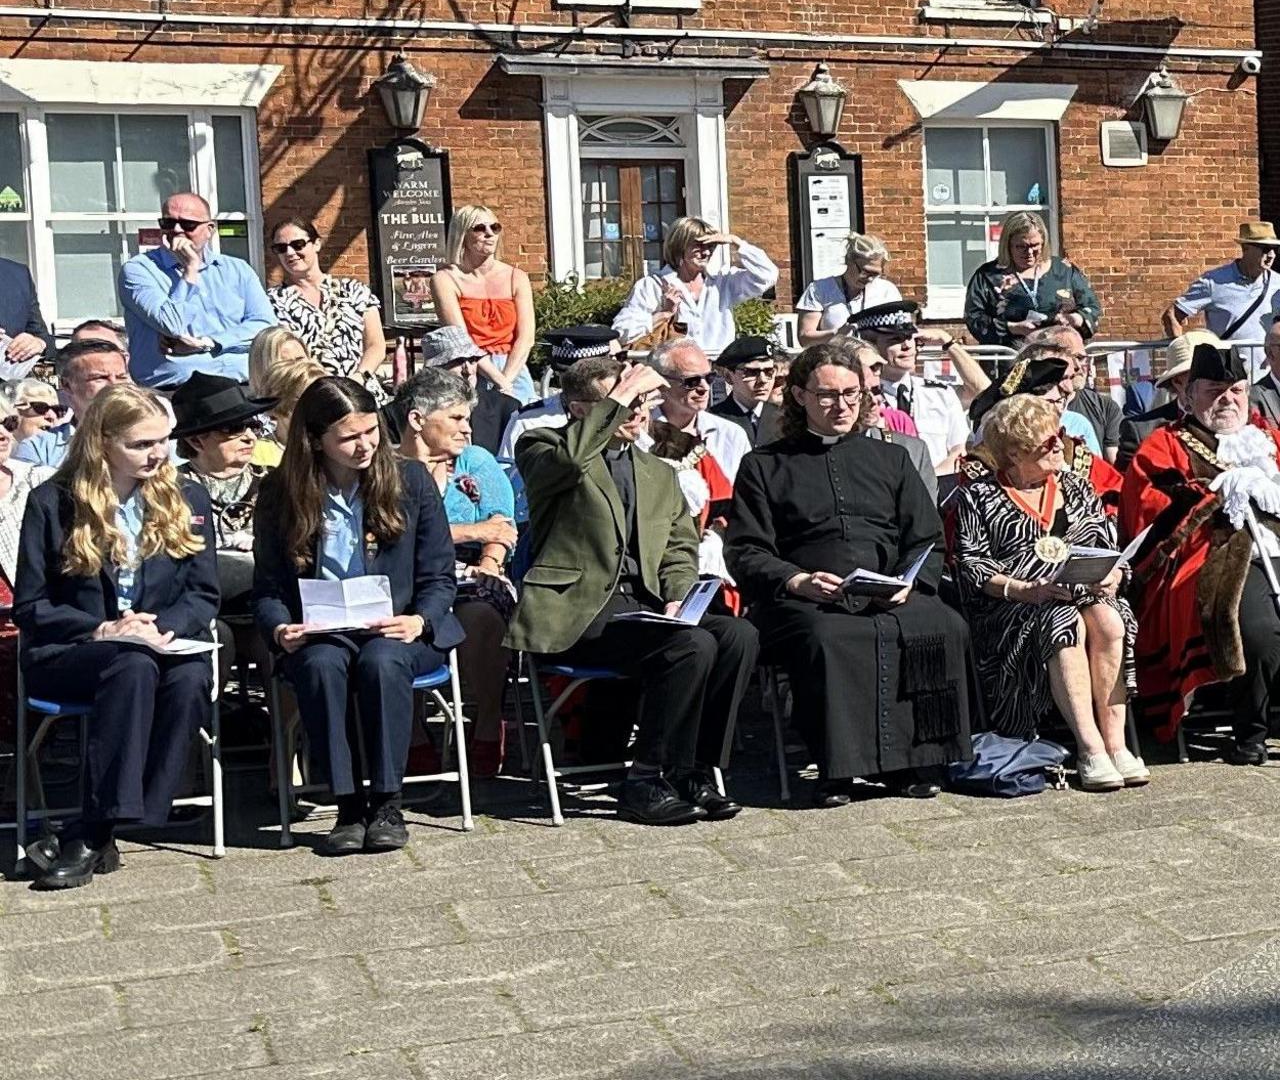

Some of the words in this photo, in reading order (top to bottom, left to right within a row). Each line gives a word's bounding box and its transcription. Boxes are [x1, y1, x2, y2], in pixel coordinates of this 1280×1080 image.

[393, 180, 428, 189] WARM
[382, 189, 441, 198] WELCOME
[381, 213, 409, 224] THE
[411, 213, 445, 224] BULL
[402, 241, 437, 252] Lagers
[386, 255, 408, 264] Beer
